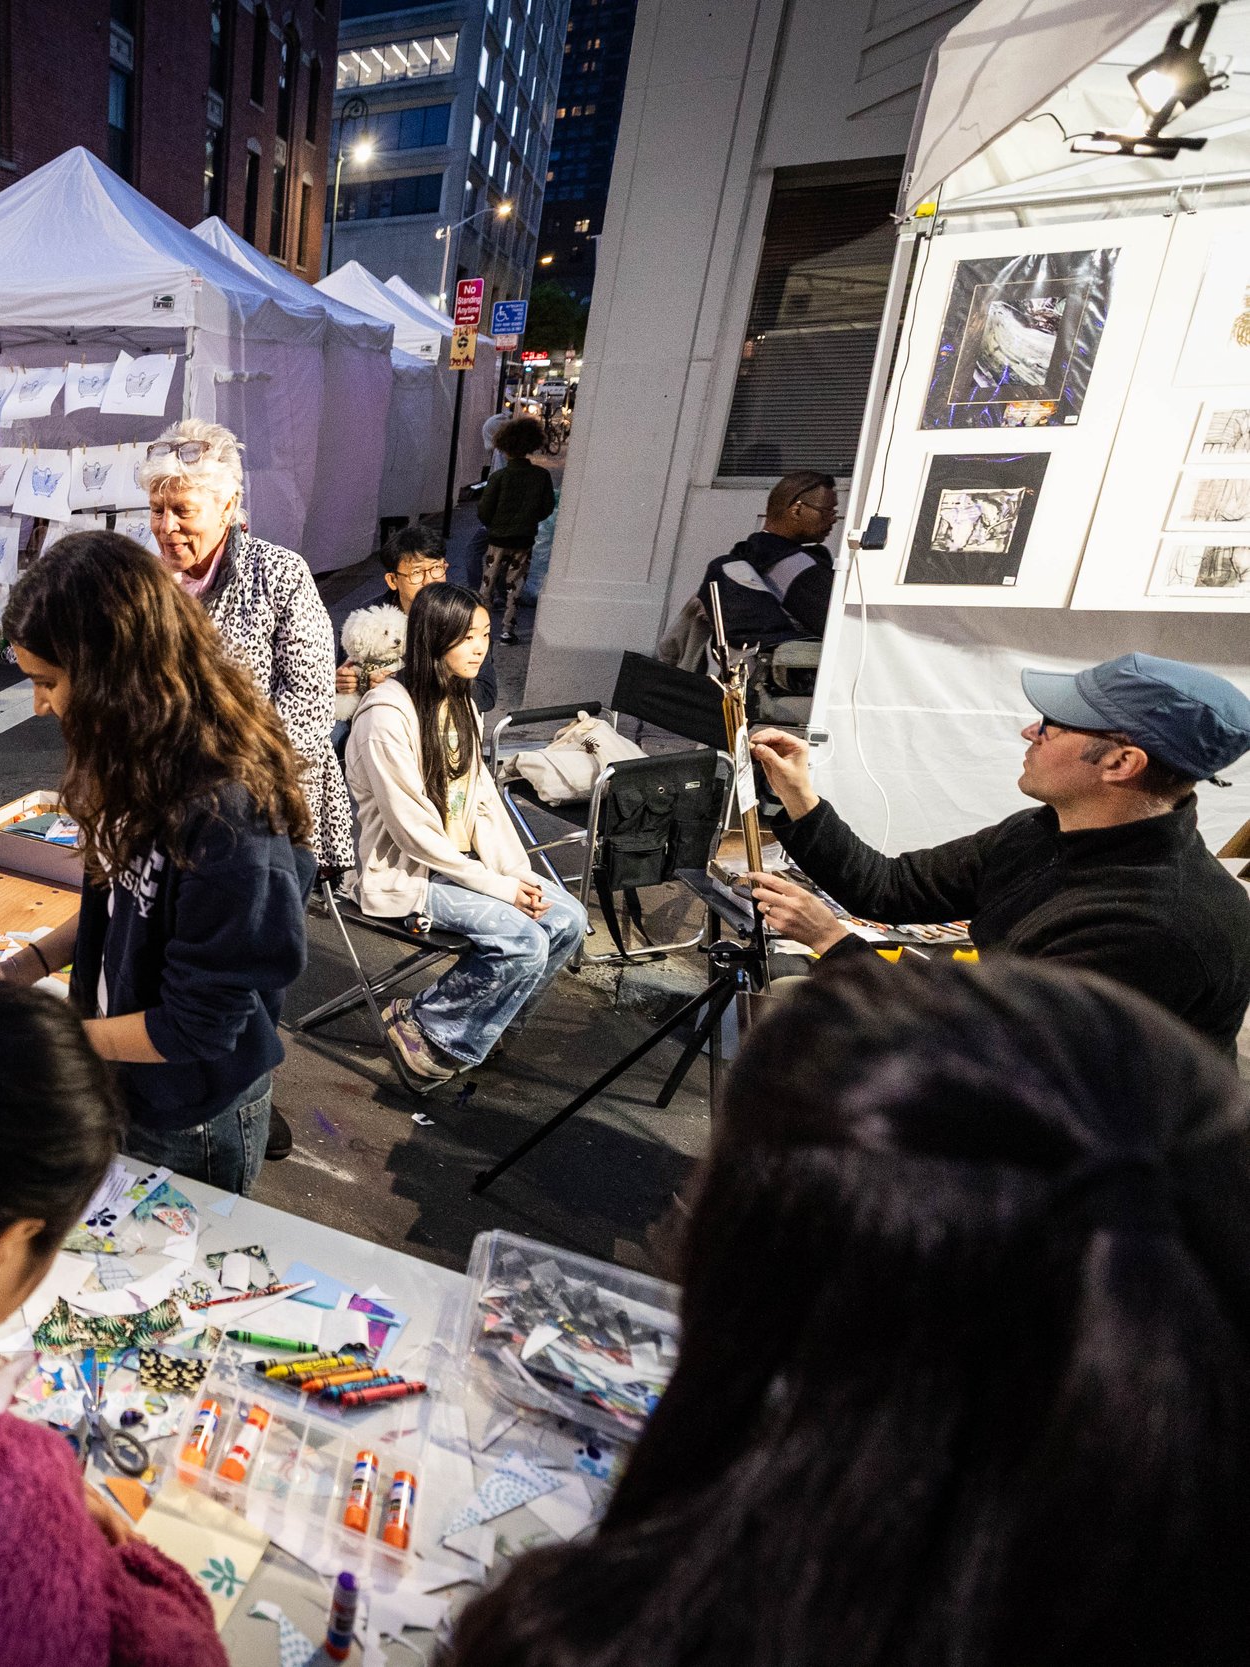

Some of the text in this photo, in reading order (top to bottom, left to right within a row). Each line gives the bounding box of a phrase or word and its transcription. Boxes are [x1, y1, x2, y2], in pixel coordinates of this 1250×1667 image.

[463, 285, 476, 294] No
[457, 296, 481, 305] Standing
[457, 306, 479, 316] Anytime
